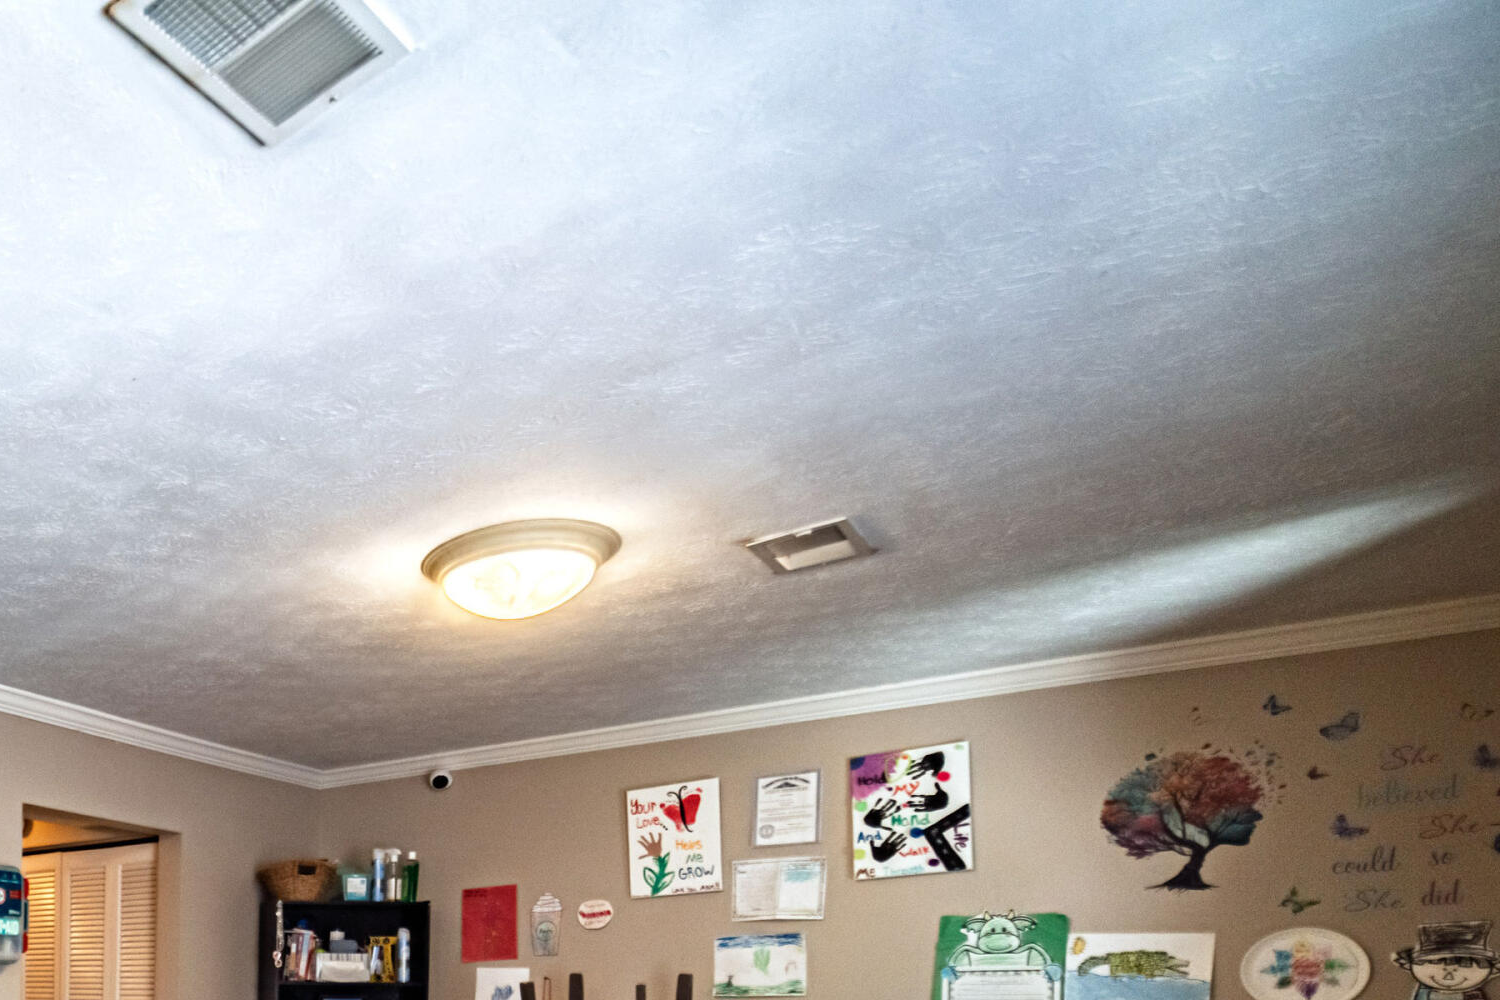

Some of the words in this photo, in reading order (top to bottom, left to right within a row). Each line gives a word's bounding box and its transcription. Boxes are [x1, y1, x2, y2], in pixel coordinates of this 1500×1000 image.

[1380, 745, 1441, 771] She
[1358, 774, 1460, 808] believed
[1419, 813, 1479, 839] She
[1332, 846, 1397, 874] could
[1430, 852, 1453, 866] so
[1344, 888, 1405, 912] She
[1421, 878, 1461, 907] did
